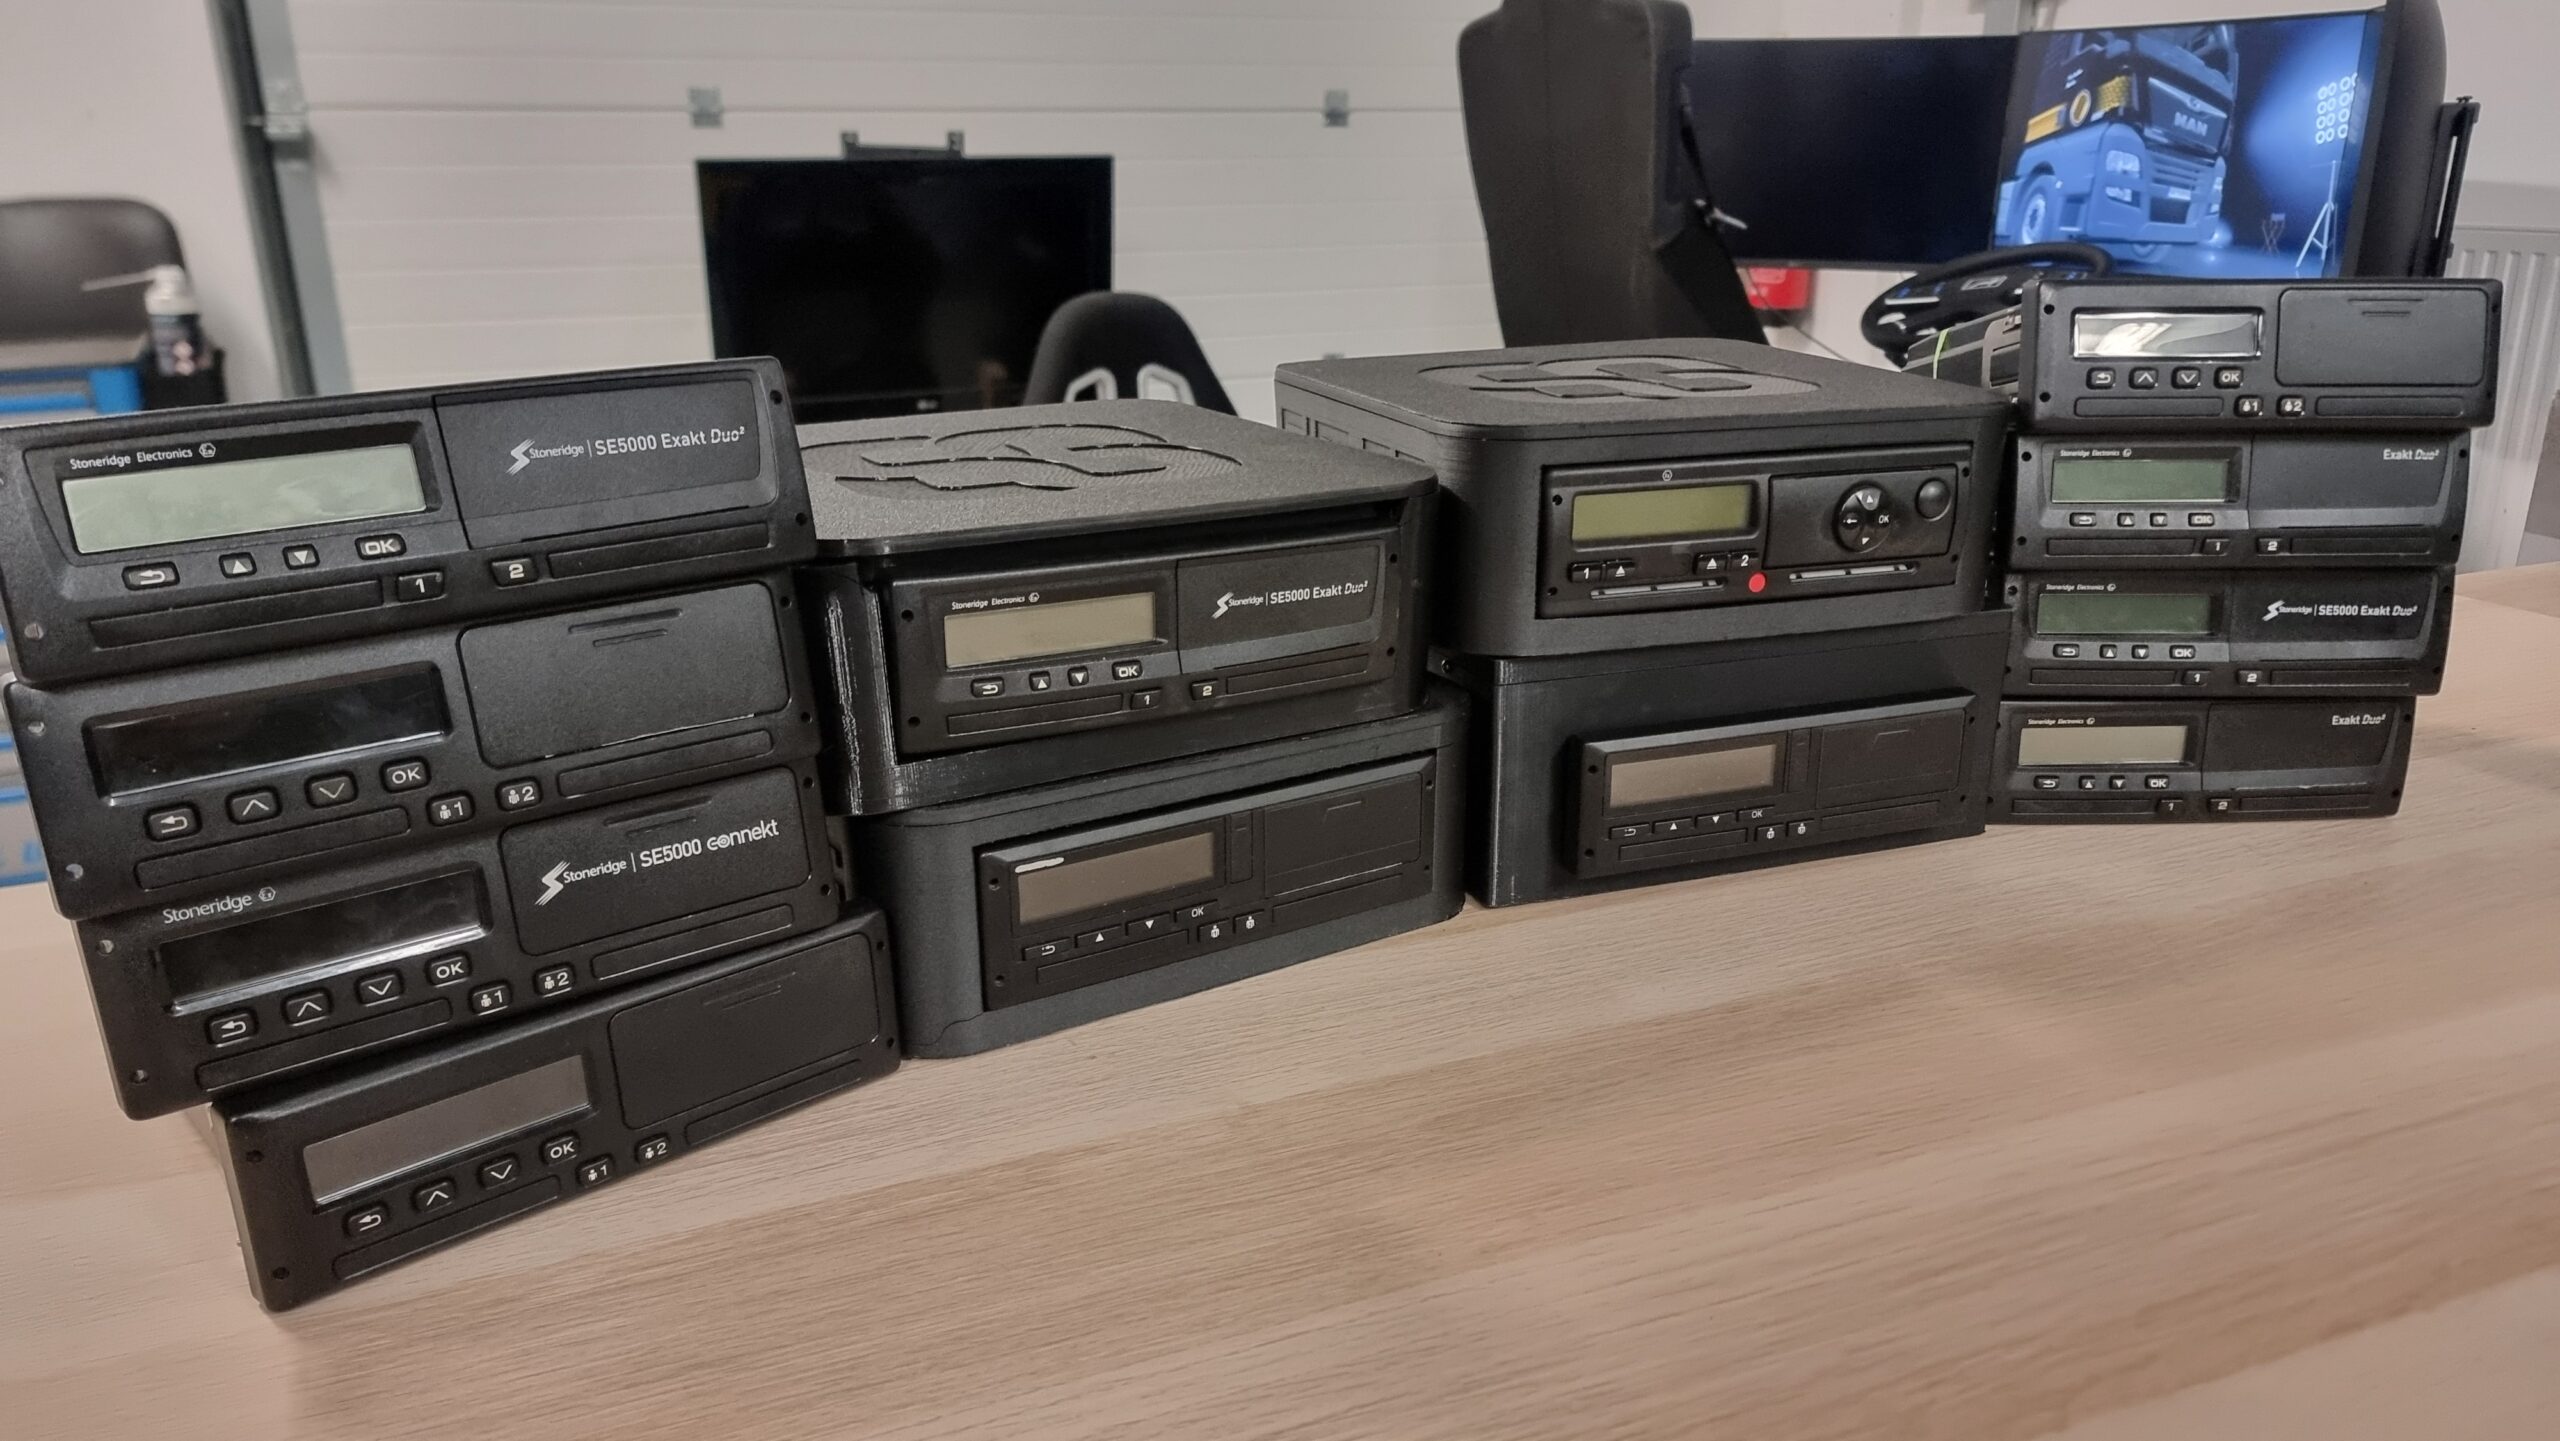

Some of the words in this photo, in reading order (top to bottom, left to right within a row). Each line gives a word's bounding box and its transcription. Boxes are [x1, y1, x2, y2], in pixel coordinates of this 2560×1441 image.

[2221, 372, 2240, 383] OK
[2252, 401, 2258, 412] 1
[2293, 401, 2302, 412] 2
[529, 443, 584, 460] Stoneridge
[594, 434, 657, 456] SE5000
[661, 431, 707, 449] Exakt
[70, 455, 131, 470] Stoneridge
[136, 447, 193, 463] Electronics
[2383, 448, 2413, 460] Exakt
[1878, 514, 1890, 524] OK
[364, 538, 396, 556] OK
[2215, 541, 2221, 551] 1
[2267, 541, 2278, 551] 2
[1741, 554, 1750, 567] 2
[508, 563, 525, 579] 2
[1583, 567, 1590, 579] 1
[415, 578, 426, 593] 1
[1270, 588, 1311, 604] SE5000
[1312, 584, 1343, 599] Exakt
[951, 600, 989, 611] Stoneridge
[991, 595, 1026, 606] Electronics
[2318, 605, 2359, 616] SE5000
[2360, 605, 2391, 616] Exakt
[2174, 648, 2193, 658] OK
[1118, 665, 1139, 678] OK
[2193, 673, 2201, 683] 1
[2246, 673, 2258, 683] 2
[1202, 685, 1213, 697] 2
[1143, 694, 1151, 705] 1
[2332, 715, 2361, 726] Exakt
[391, 766, 422, 785] OK
[2150, 779, 2168, 788] OK
[521, 785, 536, 803] 2
[453, 801, 464, 817] 1
[2168, 802, 2174, 811] 1
[2217, 801, 2228, 811] 2
[1751, 809, 1764, 819] OK
[562, 860, 627, 883] Stoneridge
[639, 838, 702, 867] SE5000
[163, 895, 253, 924] Stoneridge
[1191, 906, 1205, 918] OK
[436, 961, 465, 979] OK
[556, 971, 570, 987] 2
[494, 989, 504, 1003] 1
[550, 1141, 576, 1159] OK
[656, 1141, 667, 1156] 2
[600, 1164, 608, 1176] 1
